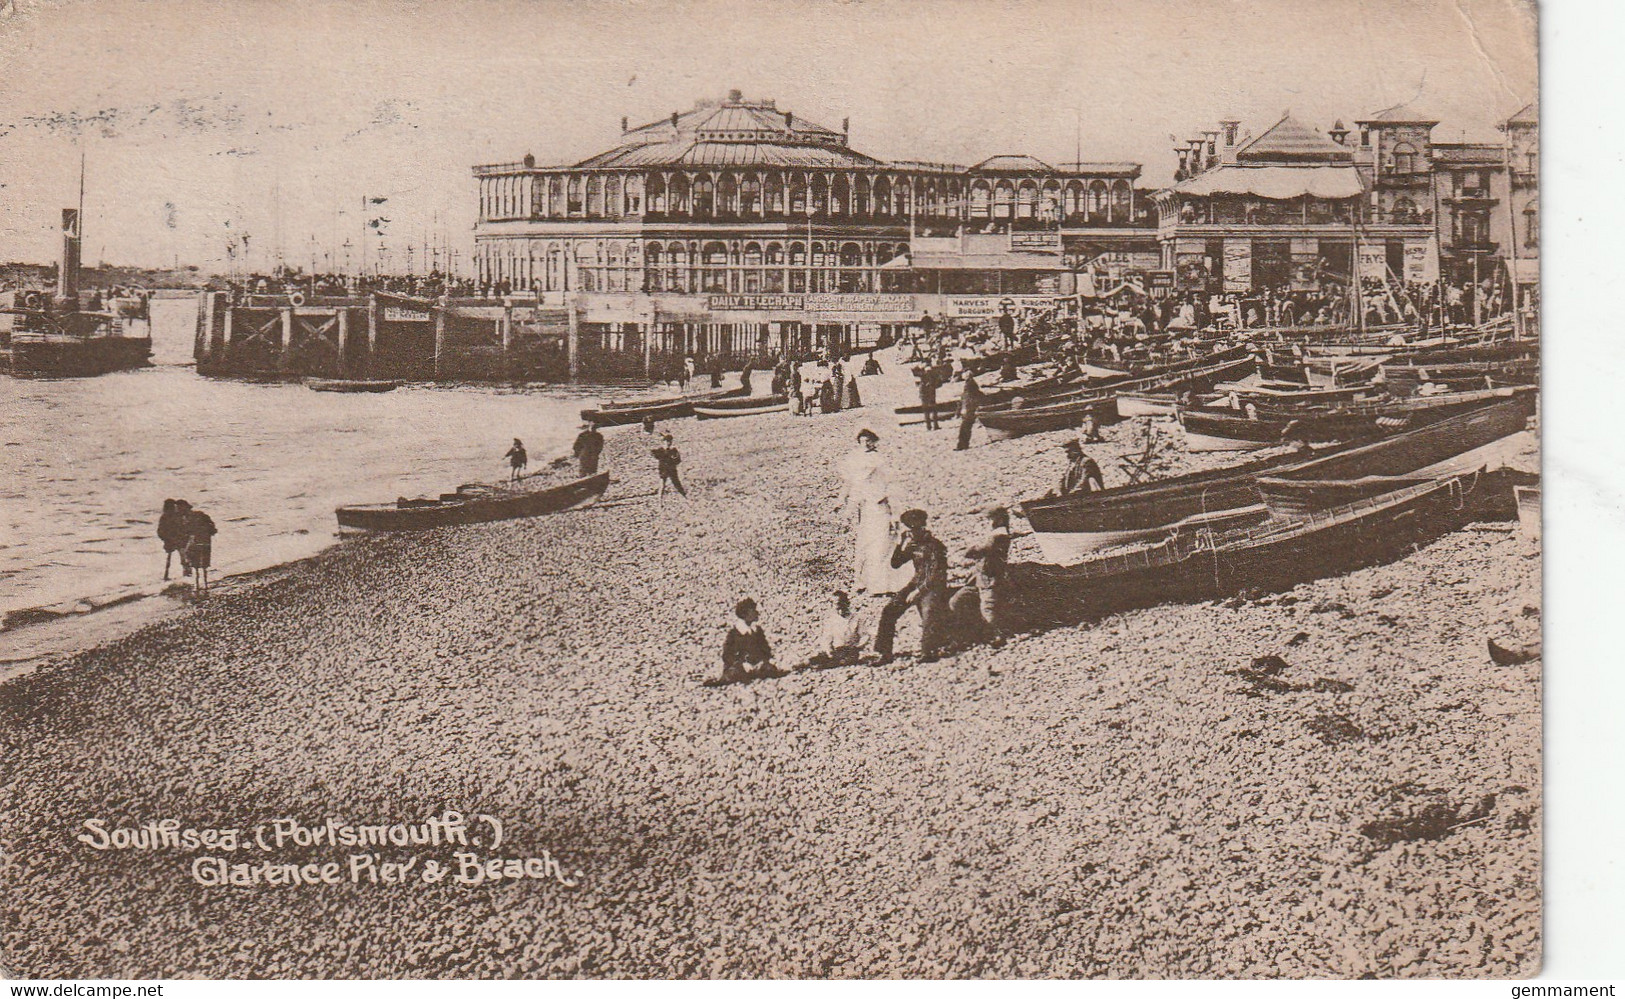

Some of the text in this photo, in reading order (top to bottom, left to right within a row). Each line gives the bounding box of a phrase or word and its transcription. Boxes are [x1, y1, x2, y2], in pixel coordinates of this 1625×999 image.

[711, 296, 802, 306] DAILY TELEGRAPH
[958, 307, 995, 315] BURGUNDY
